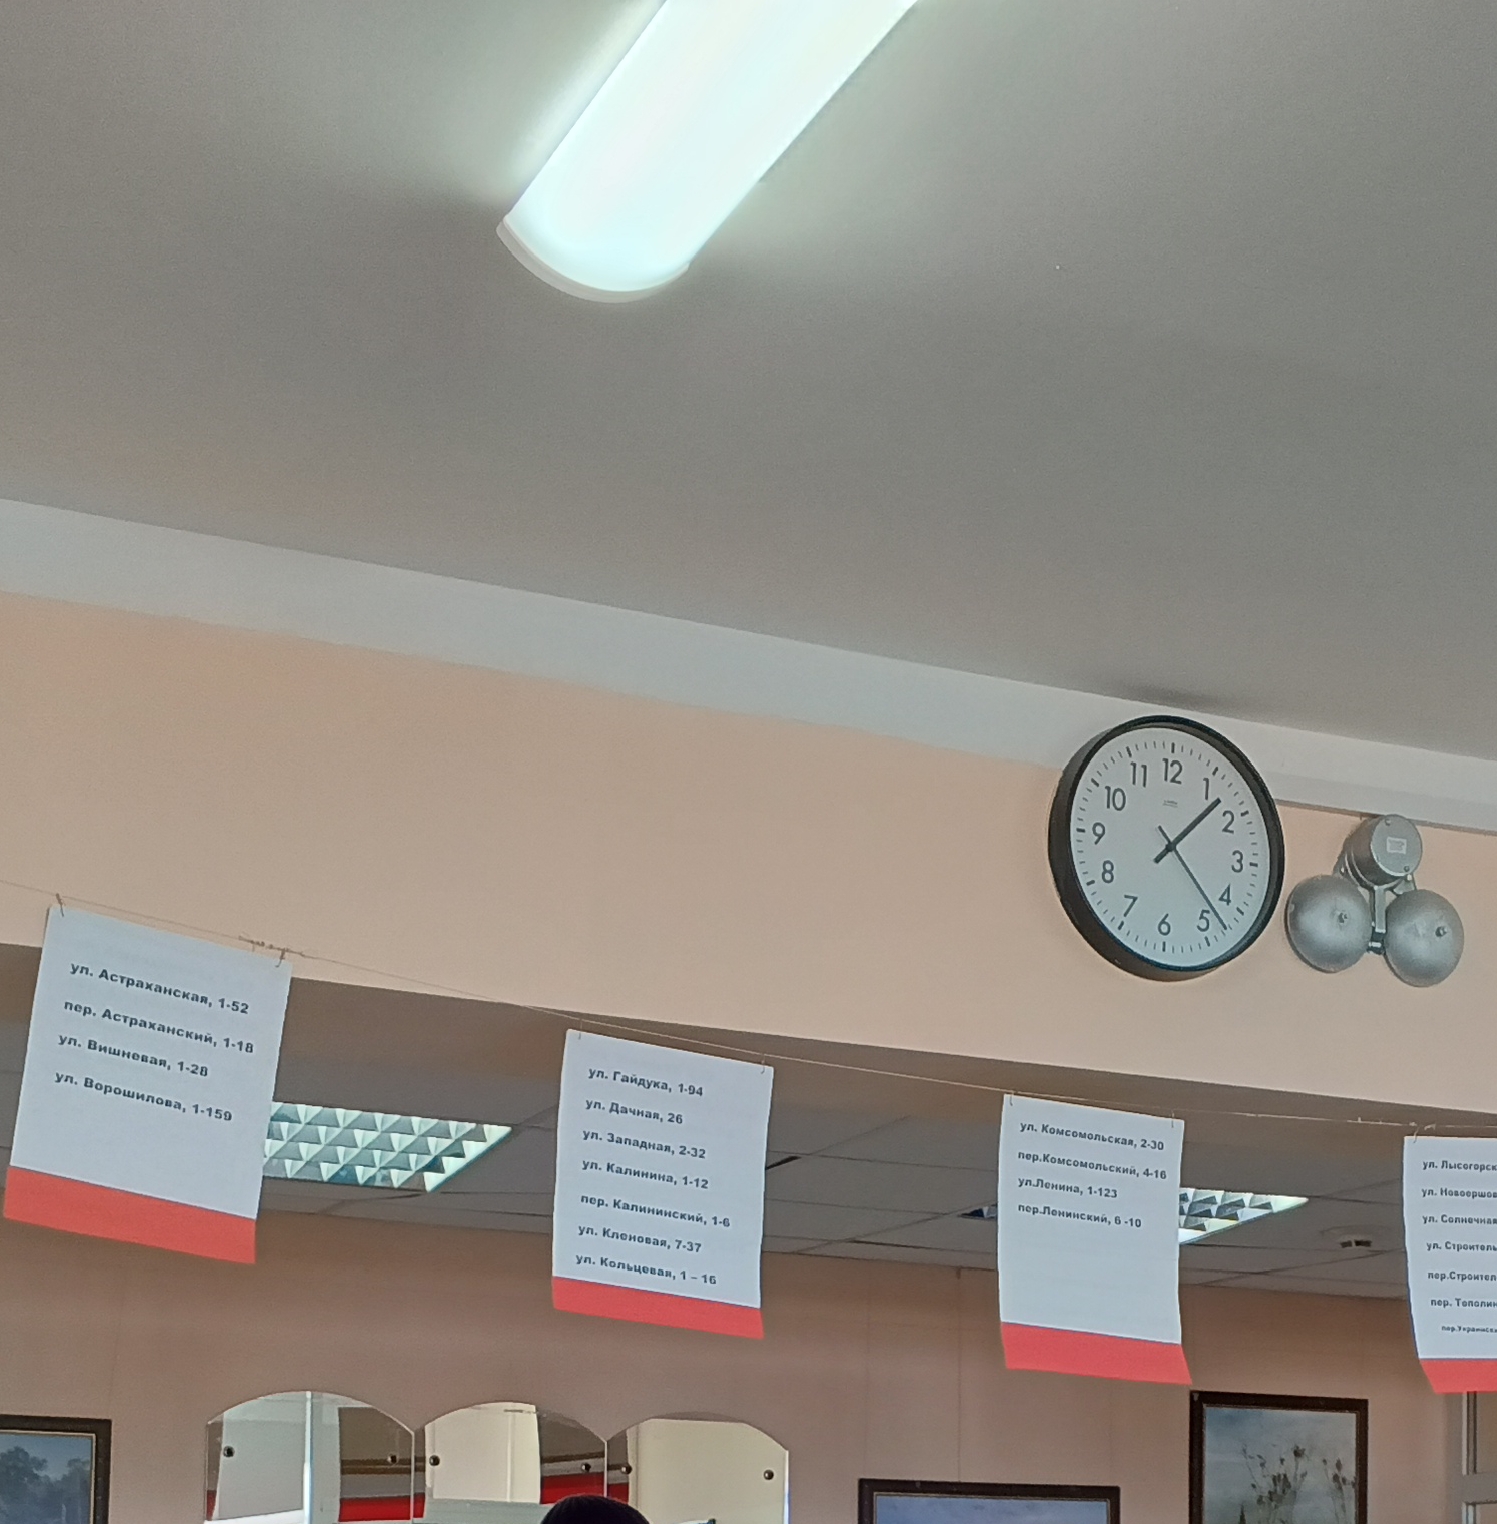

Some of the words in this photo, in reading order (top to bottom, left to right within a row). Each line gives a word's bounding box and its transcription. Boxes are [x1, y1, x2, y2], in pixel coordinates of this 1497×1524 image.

[1130, 762, 1148, 787] 11
[1162, 758, 1183, 785] 12
[1105, 786, 1126, 811] 10
[1203, 778, 1211, 800] 1
[1092, 822, 1105, 844] 9
[1222, 811, 1235, 833] 2
[1102, 860, 1114, 884] 8
[1231, 851, 1244, 873] 3
[1124, 895, 1138, 917] 7
[1219, 884, 1232, 906] 4
[1158, 913, 1171, 936] 6
[1197, 910, 1211, 932] 5
[70, 964, 93, 976] ул.
[99, 969, 212, 1007] Астраханская,
[218, 998, 249, 1014] 1-52
[64, 1002, 96, 1016] пер.
[102, 1009, 218, 1048] Астраханский,
[224, 1038, 253, 1053] 1-18
[58, 1035, 81, 1047] ул.
[88, 1040, 170, 1070] Вишневая,
[178, 1061, 208, 1077] 1-28
[588, 1069, 608, 1079] ул.
[613, 1071, 671, 1093] Гайдука,
[678, 1083, 703, 1096] 1-94
[55, 1073, 77, 1085] ул.
[84, 1077, 186, 1113] Ворошилова,
[192, 1104, 232, 1121] 1-159
[586, 1100, 605, 1110] ул.
[609, 1102, 663, 1123] Дачная,
[667, 1113, 682, 1124] 26
[583, 1131, 602, 1140] ул.
[607, 1133, 674, 1155] Западная,
[679, 1146, 705, 1159] 2-32
[1020, 1123, 1037, 1132] ул.
[1041, 1124, 1137, 1148] Комсомольская,
[1141, 1139, 1164, 1150] 2-30
[582, 1160, 602, 1170] ул.
[607, 1162, 677, 1185] Калинина,
[682, 1176, 708, 1189] 1-12
[1143, 1168, 1166, 1179] 4-16
[1423, 1162, 1438, 1170] ул.
[1087, 1186, 1117, 1198] 1-123
[1422, 1189, 1437, 1197] ул.
[581, 1196, 608, 1208] пер.
[613, 1199, 707, 1225] Калининский,
[712, 1216, 730, 1227] 1-6
[1422, 1216, 1437, 1224] ул.
[578, 1226, 597, 1236] ул.
[603, 1227, 670, 1249] Кленовая,
[675, 1239, 701, 1252] 7-37
[1427, 1243, 1441, 1251] ул.
[576, 1255, 595, 1265] ул.
[600, 1257, 675, 1280] Кольцевая,
[1431, 1300, 1452, 1308] пер.
